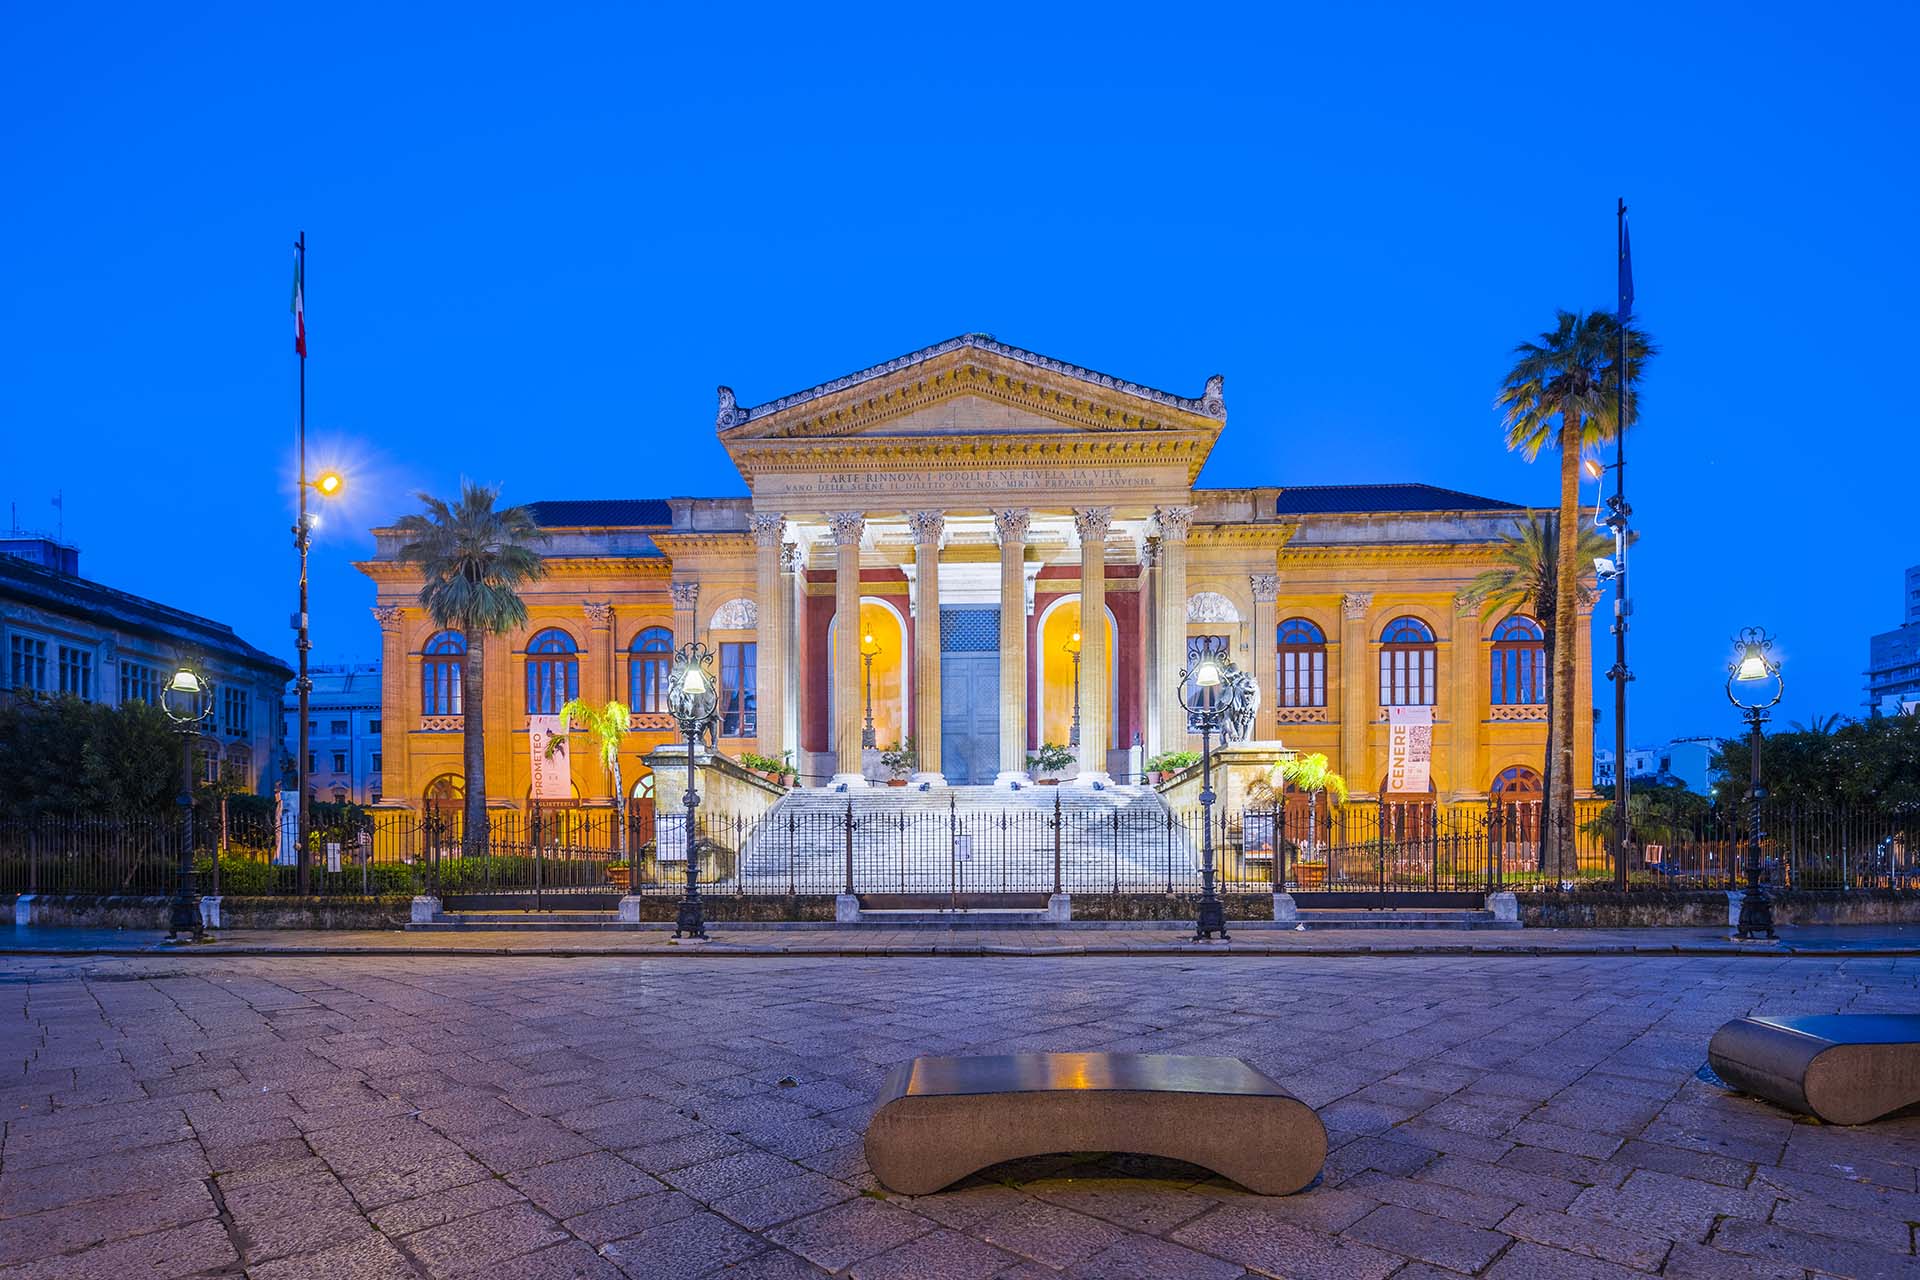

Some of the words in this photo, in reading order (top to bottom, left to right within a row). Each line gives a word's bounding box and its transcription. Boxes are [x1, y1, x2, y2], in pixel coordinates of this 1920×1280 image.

[785, 484, 813, 492] VANO
[817, 483, 845, 491] DELLE
[851, 483, 885, 491] SCENE
[906, 481, 945, 490] DILETTO
[977, 480, 999, 489] NON
[1006, 480, 1029, 488] MIRI
[1034, 480, 1040, 488] A
[1044, 479, 1095, 488] PREPARAR
[819, 473, 860, 483] L'ARTE
[866, 472, 921, 483] RINNOVA
[938, 471, 980, 481] POPOLI
[987, 471, 993, 480] E
[1000, 470, 1014, 480] NE
[1022, 470, 1066, 480] RIVELA
[1073, 469, 1087, 479] LA
[1093, 469, 1122, 479] VITA
[533, 733, 543, 795] PROMETEO
[1392, 725, 1405, 789] CENERE
